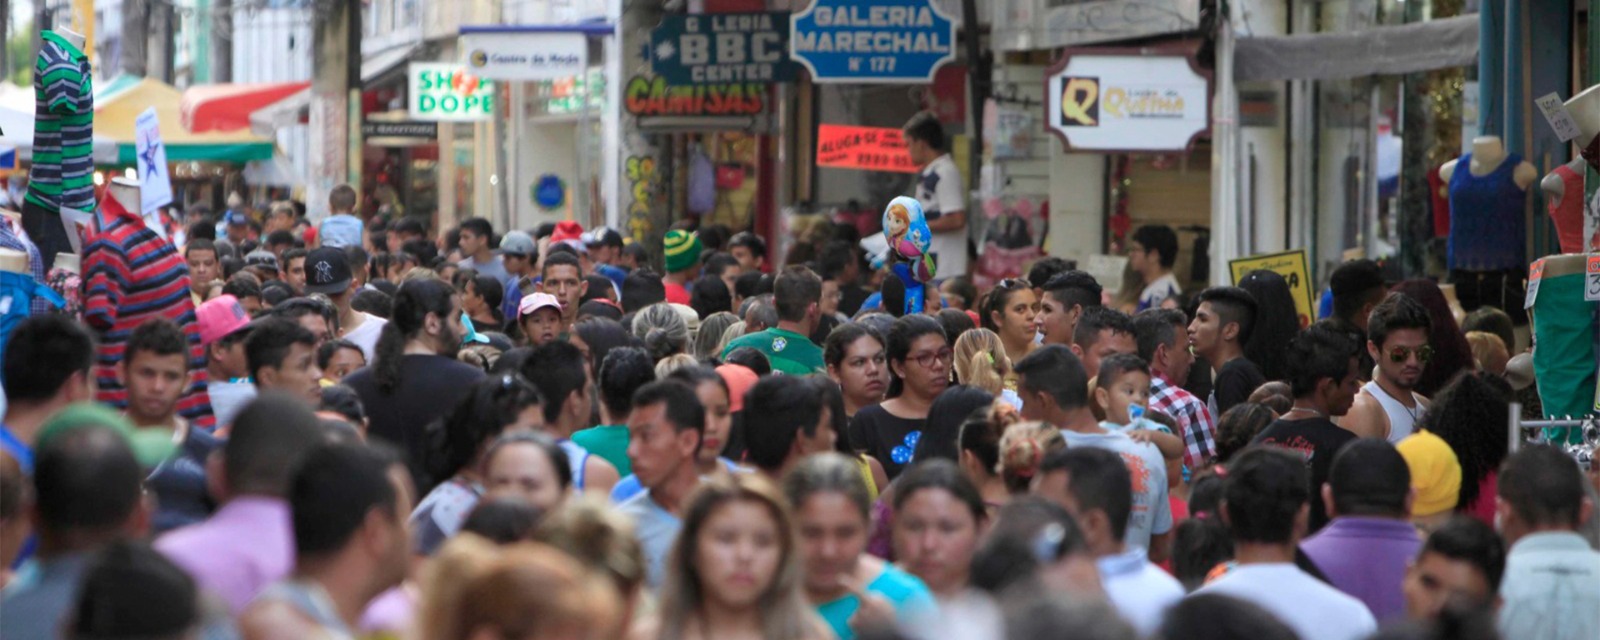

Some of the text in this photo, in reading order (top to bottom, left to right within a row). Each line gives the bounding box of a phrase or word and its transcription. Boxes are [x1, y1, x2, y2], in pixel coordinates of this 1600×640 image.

[814, 5, 934, 27] GALERIA
[679, 32, 781, 65] BBC
[796, 31, 949, 53] MARECHAL
[691, 64, 773, 82] CENTER
[870, 56, 897, 73] 177
[625, 75, 763, 115] CAMISAS
